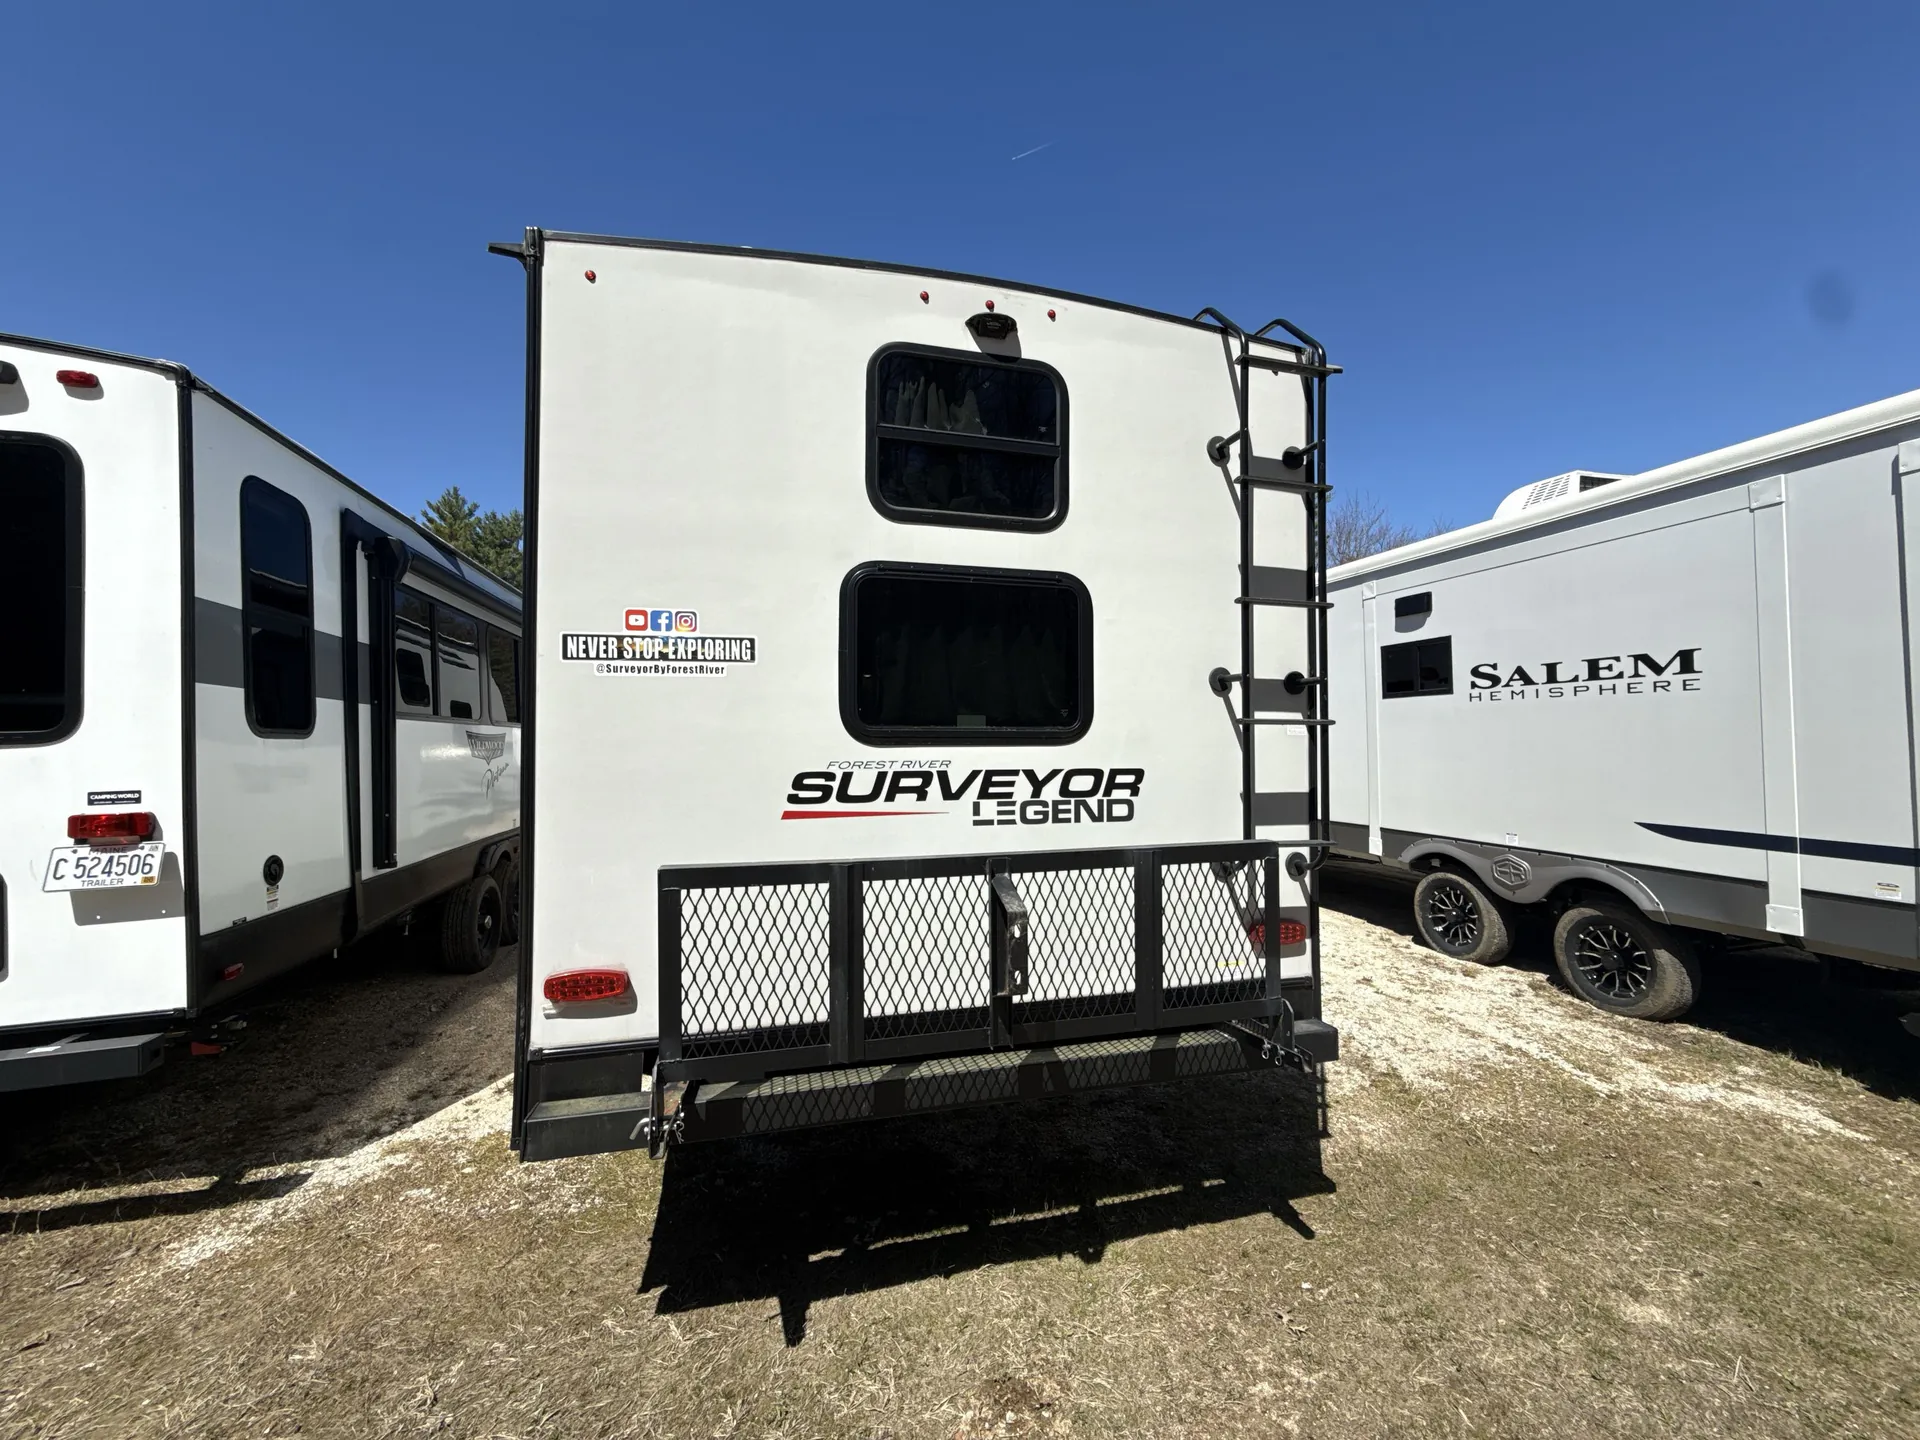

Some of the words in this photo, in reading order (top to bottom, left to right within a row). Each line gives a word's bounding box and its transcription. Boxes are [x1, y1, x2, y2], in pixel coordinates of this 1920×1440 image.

[567, 636, 618, 659] NEVER
[622, 637, 663, 660] STOP
[668, 638, 751, 661] EXPLORING
[596, 663, 725, 676] @SurveyorByForestRiver
[1470, 647, 1703, 690] SALEM
[1469, 678, 1701, 702] HEMISPHERE
[826, 760, 899, 770] FOREST
[900, 759, 952, 769] RIVER
[786, 767, 1146, 804] SURVEYOR
[972, 799, 1135, 826] LEGEND
[89, 846, 128, 855] MAINE
[53, 858, 69, 880] C
[73, 854, 155, 879] 524506
[81, 878, 124, 887] TRAILER
